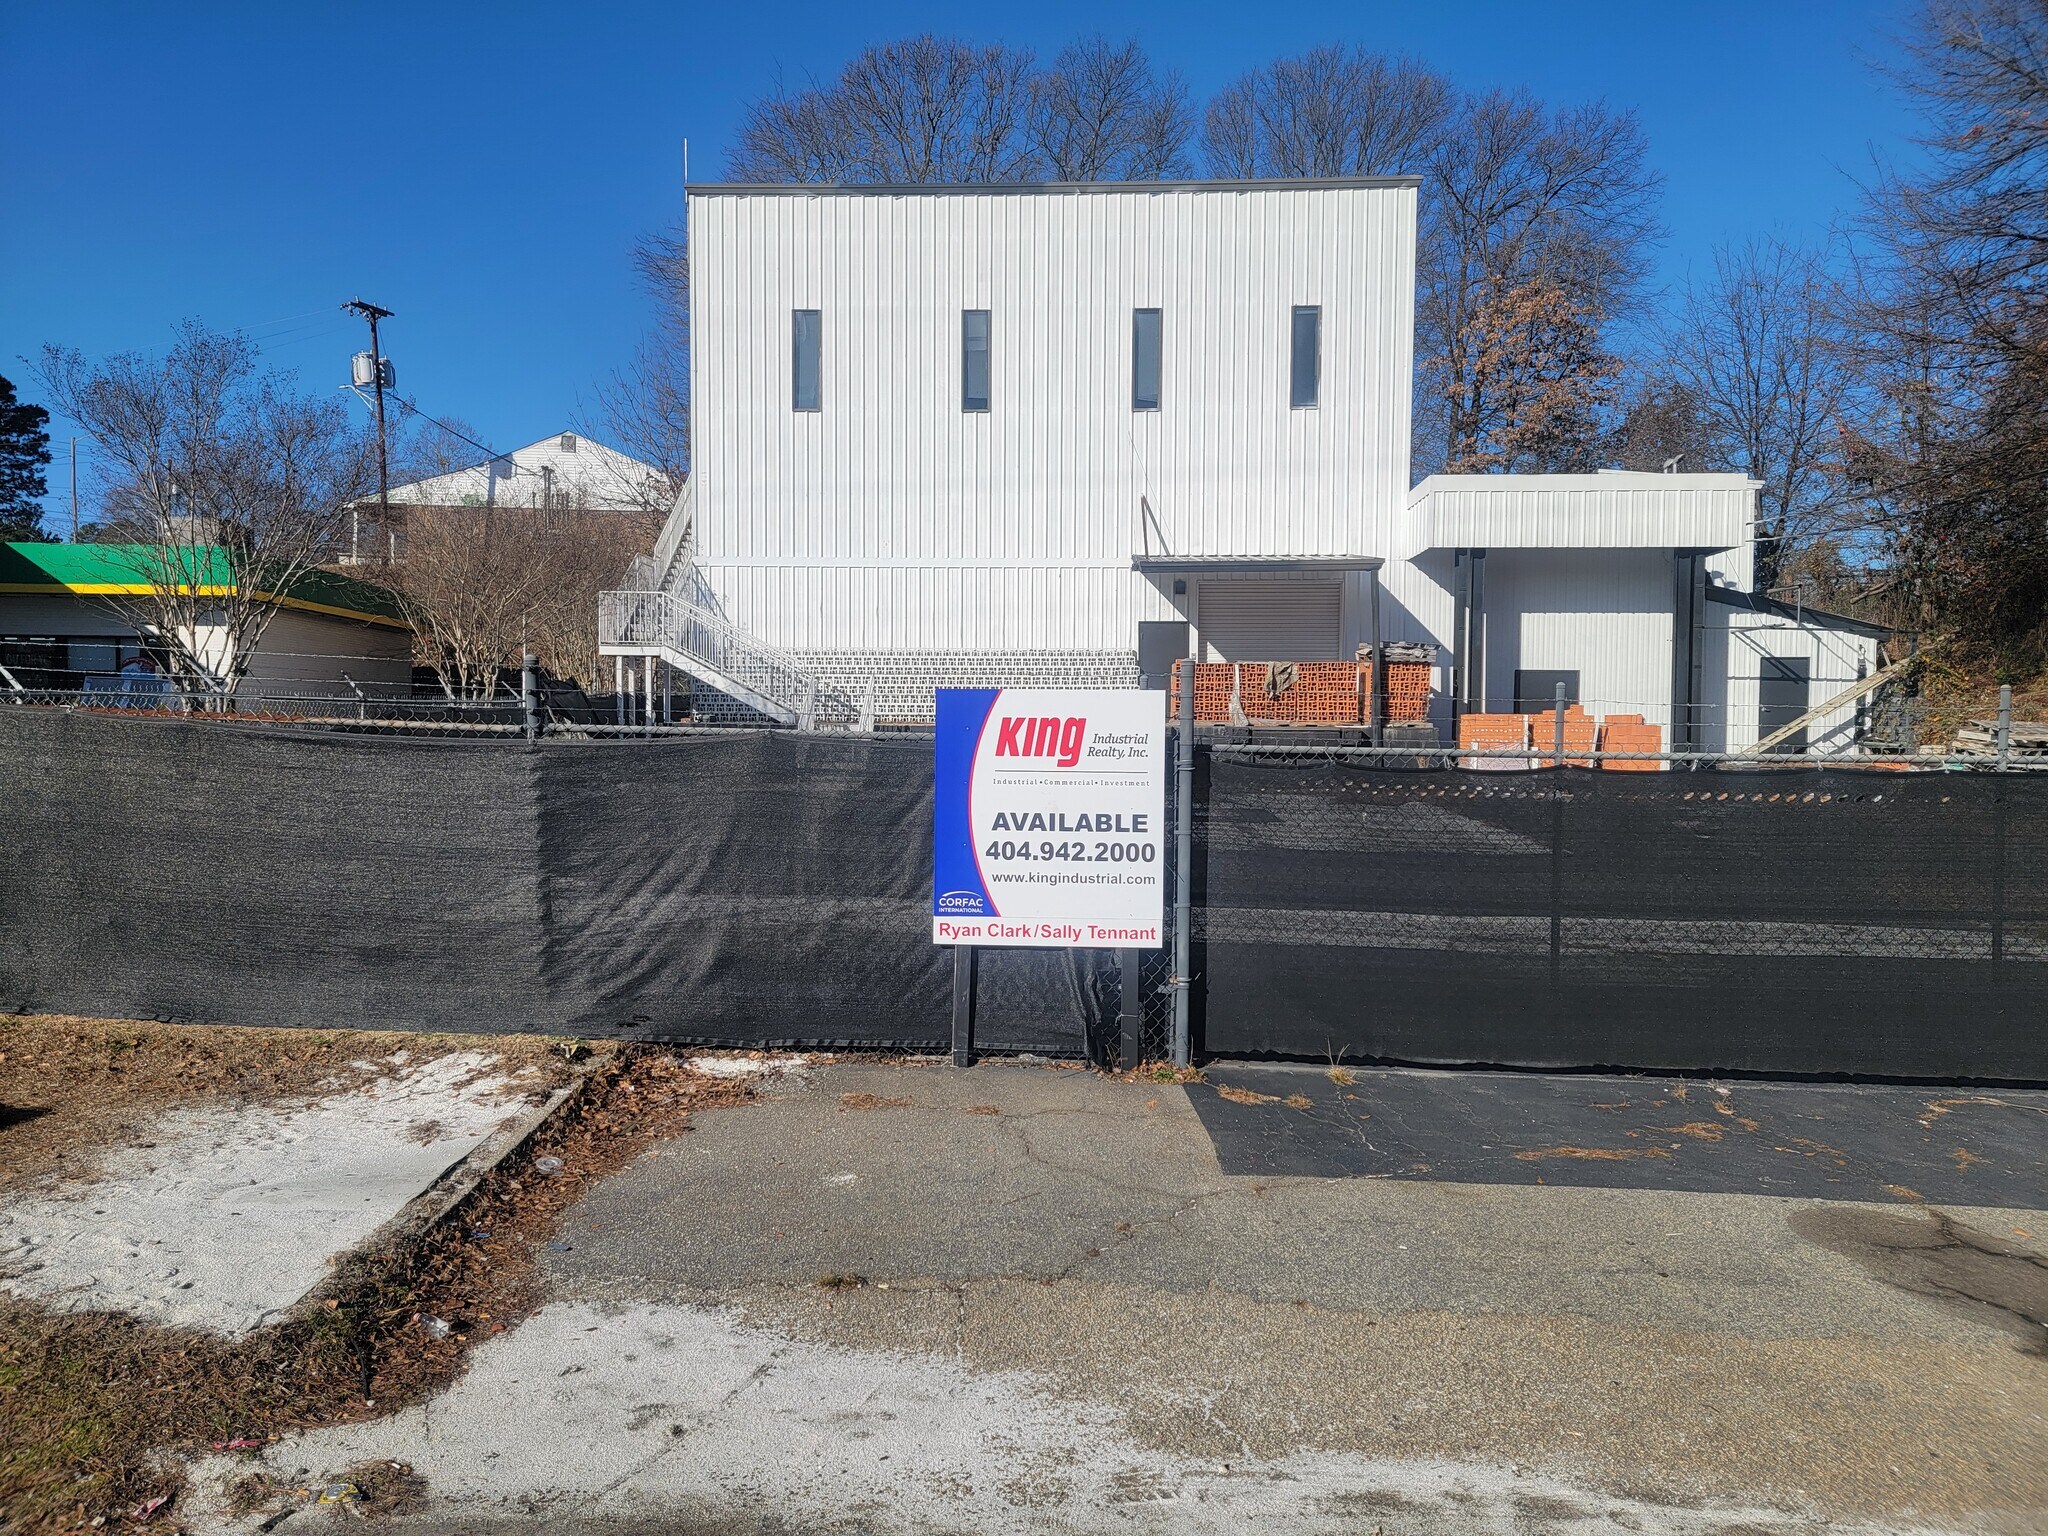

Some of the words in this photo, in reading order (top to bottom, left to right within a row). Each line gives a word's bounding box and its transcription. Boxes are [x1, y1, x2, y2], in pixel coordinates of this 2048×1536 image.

[1092, 733, 1148, 744] Industrial
[1087, 746, 1126, 760] Realty,
[1128, 747, 1148, 757] Inc.
[1100, 779, 1150, 787] Investment
[992, 812, 1148, 833] AVAILABLE
[985, 841, 1156, 862] 404.942.2000
[992, 872, 1156, 886] www.kingindustrial.com
[939, 897, 984, 908] CORFAC
[939, 922, 981, 940] Ryan
[1088, 925, 1156, 940] Tennant
